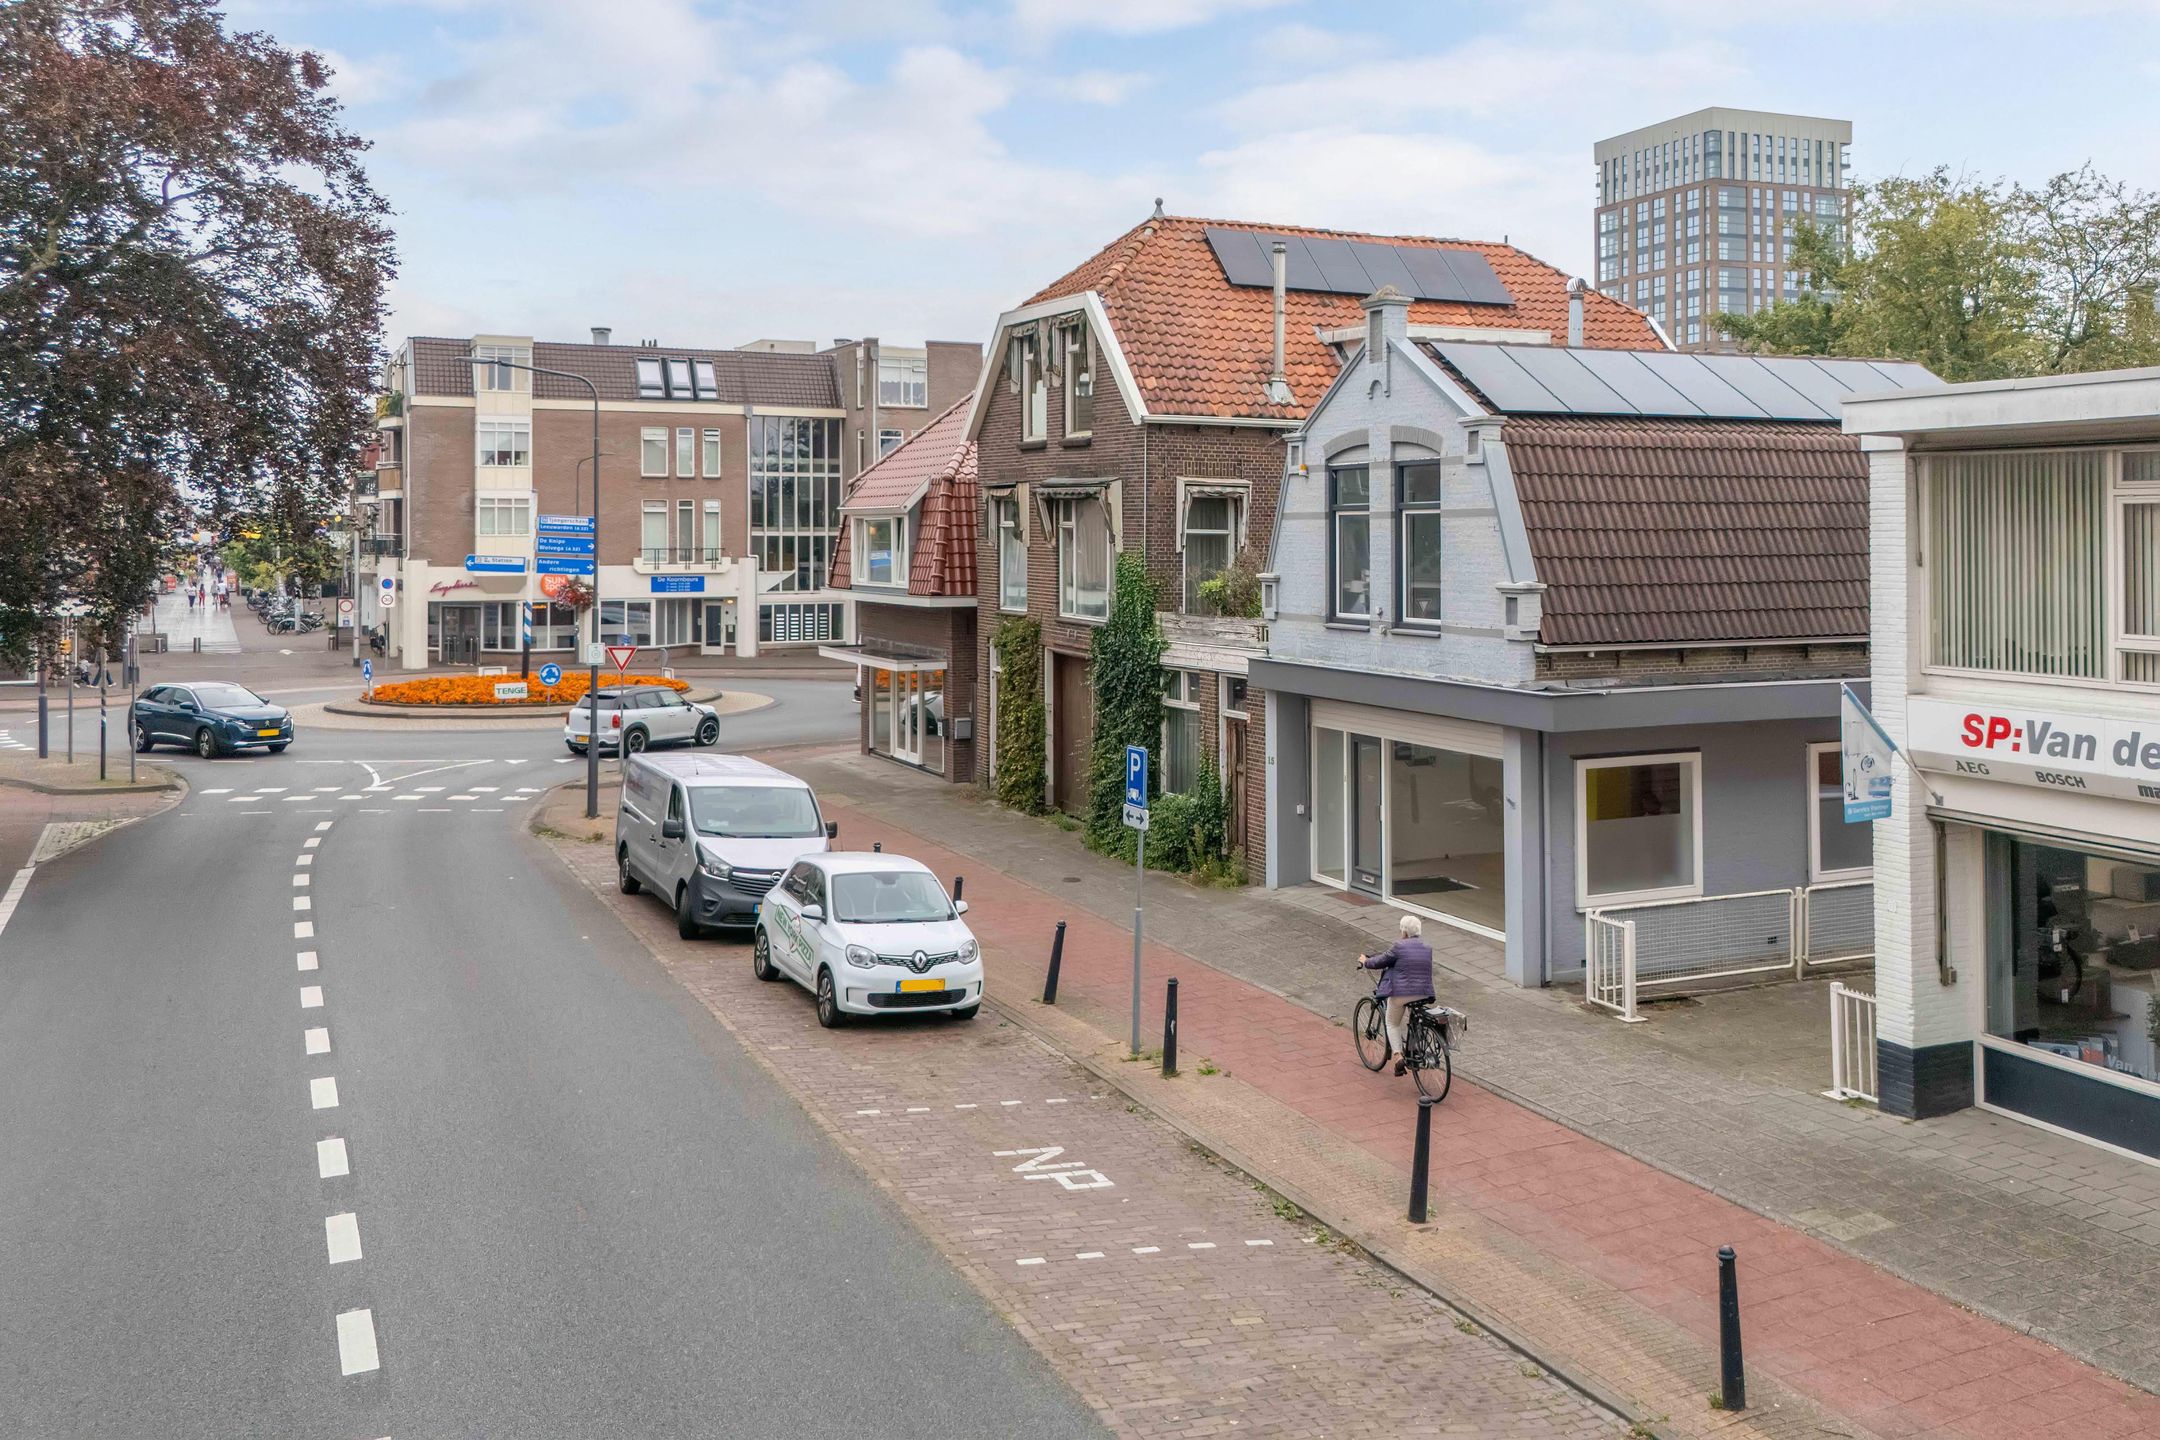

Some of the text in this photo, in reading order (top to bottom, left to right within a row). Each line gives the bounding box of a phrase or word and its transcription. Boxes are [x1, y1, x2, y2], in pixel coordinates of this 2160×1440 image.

[496, 686, 526, 695] TENGE
[1131, 752, 1141, 781] P
[1268, 756, 1275, 765] 15
[1955, 760, 1990, 775] AEG
[2035, 771, 2087, 789] BOSCH
